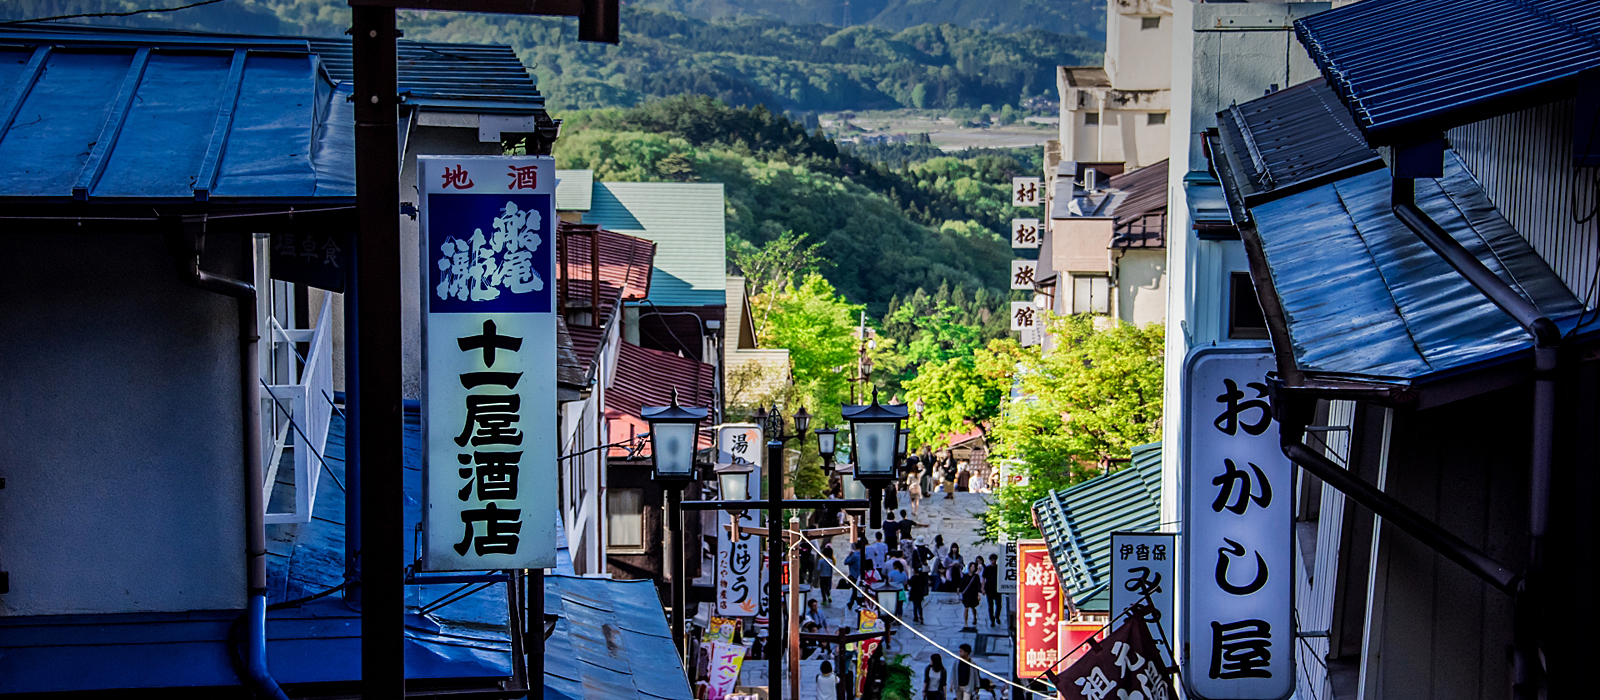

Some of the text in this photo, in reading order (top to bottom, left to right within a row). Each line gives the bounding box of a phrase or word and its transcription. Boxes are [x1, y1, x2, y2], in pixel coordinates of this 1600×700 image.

[442, 164, 538, 190] 地酒
[1014, 182, 1037, 328] 村松旅館
[453, 318, 524, 557] 十一屋酒店
[1119, 543, 1166, 561] 伊香保
[1209, 378, 1272, 680] おかし屋
[1025, 563, 1042, 627] 餃子
[1042, 555, 1057, 643] 手打ラーメン
[717, 654, 738, 697] イベント
[1026, 648, 1057, 669] 中央亭
